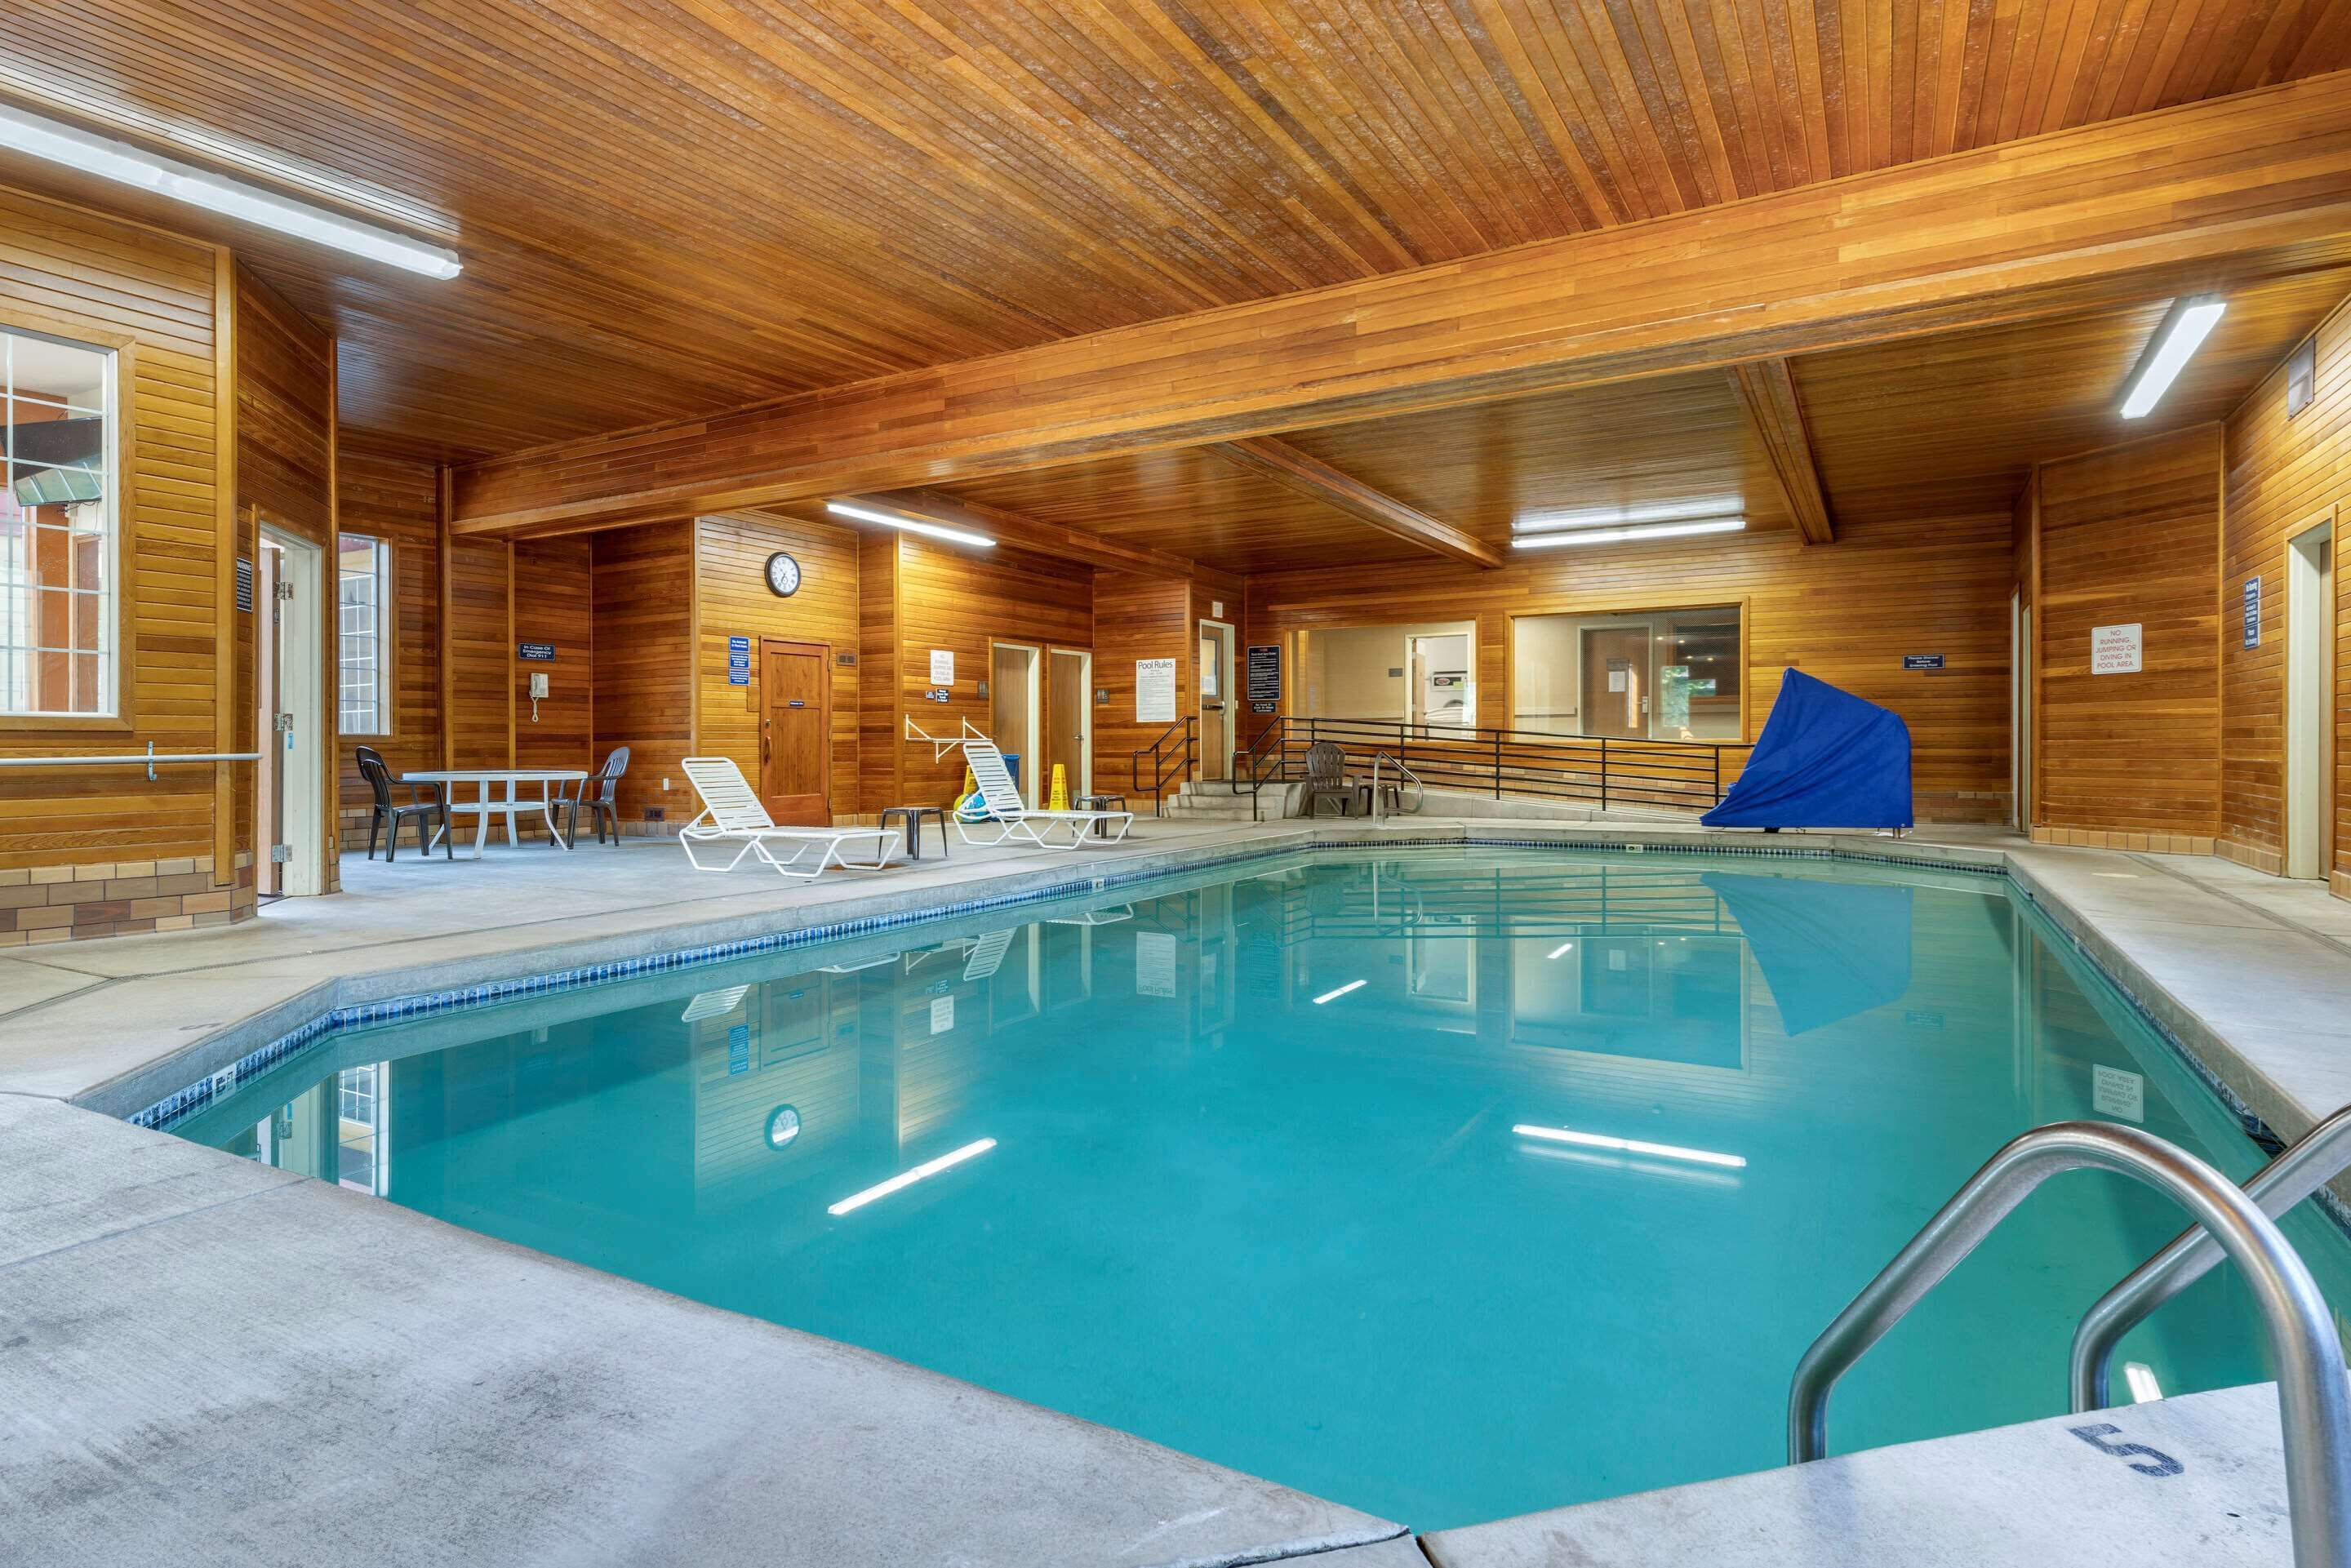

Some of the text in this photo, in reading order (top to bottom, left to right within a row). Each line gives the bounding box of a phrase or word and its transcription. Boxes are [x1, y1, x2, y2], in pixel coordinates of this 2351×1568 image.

[1138, 660, 1173, 669] Pool Rules
[2067, 1423, 2184, 1477] 5
